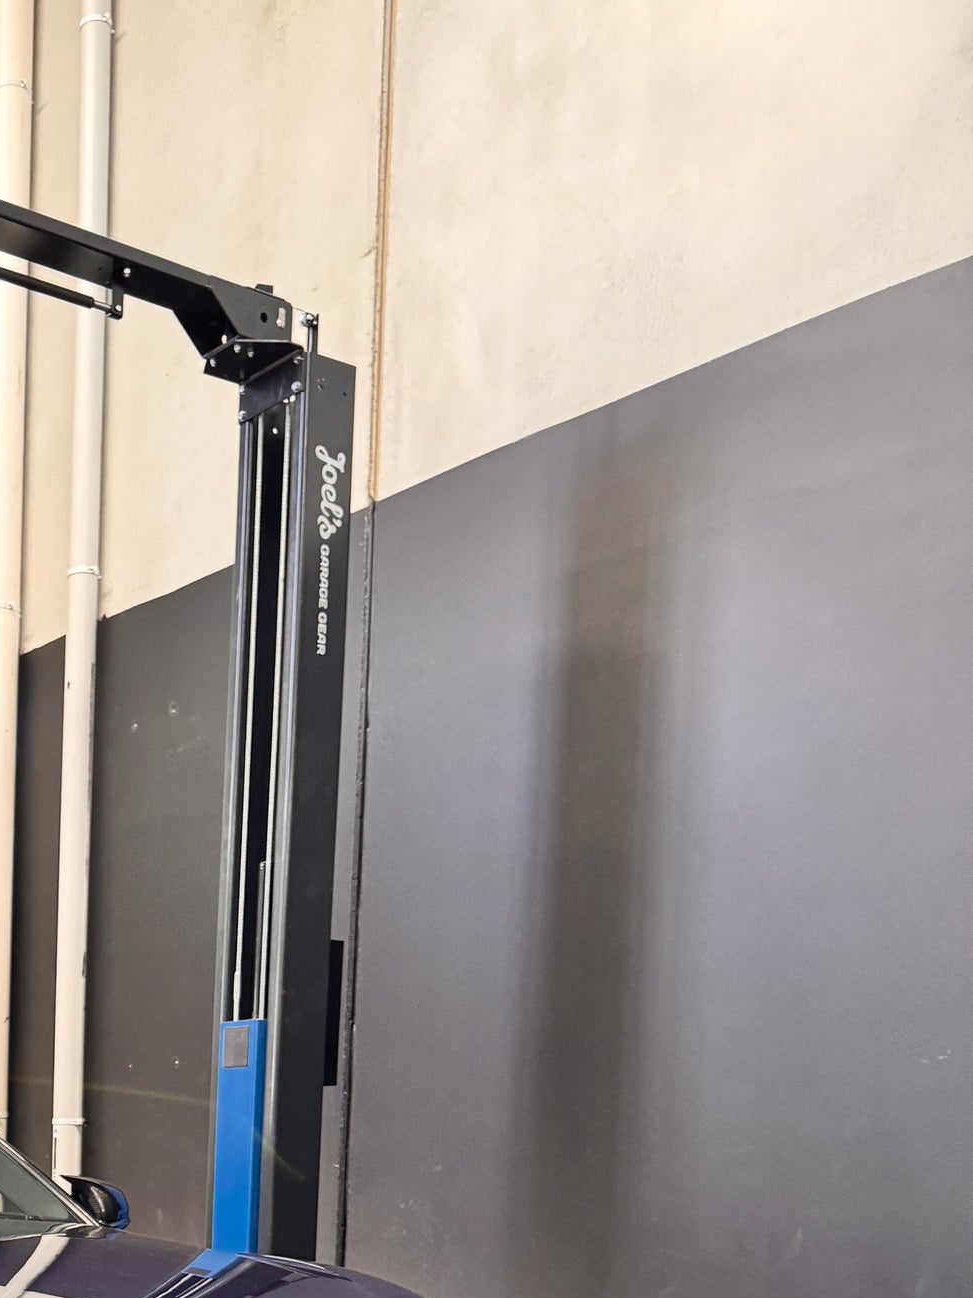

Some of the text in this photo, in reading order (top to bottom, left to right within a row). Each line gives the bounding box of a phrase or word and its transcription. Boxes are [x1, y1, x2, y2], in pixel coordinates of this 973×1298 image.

[315, 444, 346, 656] Joel's GARAGE GEAR
